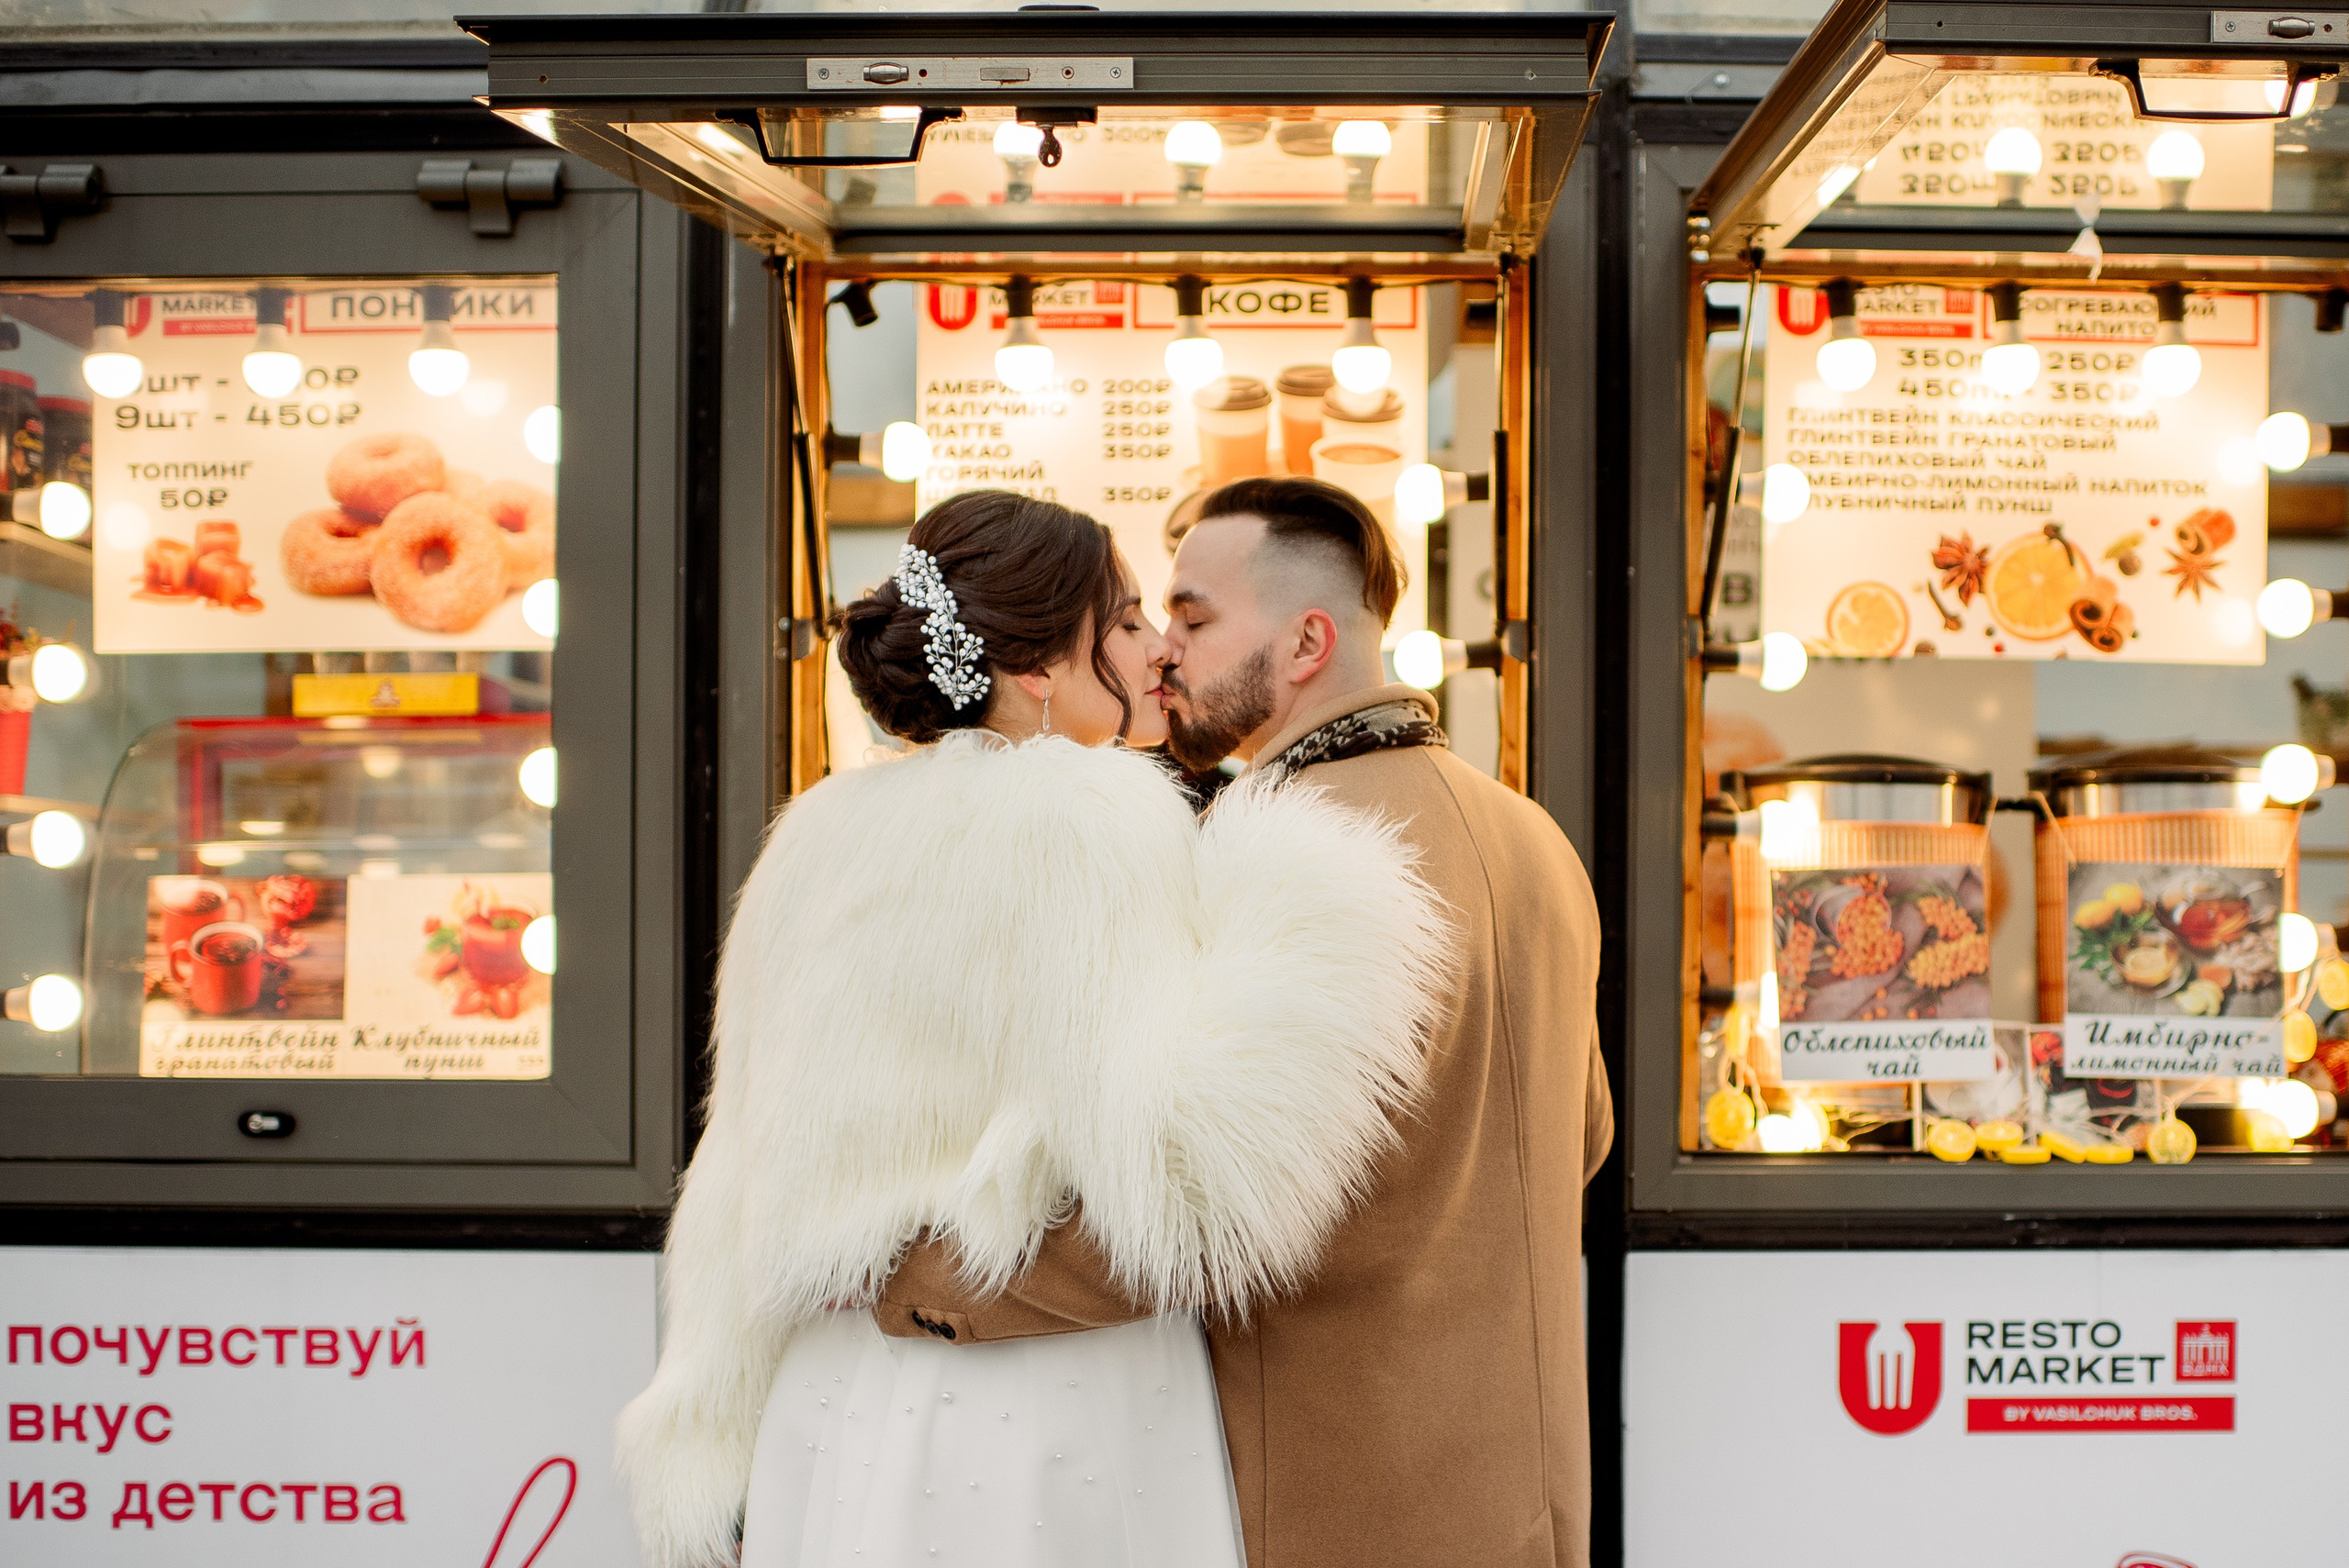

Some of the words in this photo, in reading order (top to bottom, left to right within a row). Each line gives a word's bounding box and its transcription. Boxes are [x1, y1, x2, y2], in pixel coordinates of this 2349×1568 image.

[331, 294, 536, 319] ПОНИКИ
[1208, 290, 1330, 315] КОФЕ
[1856, 299, 1938, 314] ARKET
[1788, 427, 1938, 445] ГЛИНТВЕЙН
[1950, 431, 2116, 450] ГРАНАТОВЫЙ
[1789, 449, 1985, 467] ОБЛЕПИХОВЫЙ
[1997, 451, 2047, 469] ЧАЙ
[1807, 473, 2078, 492] МБИРНО-ЛИМОННЫЙ
[2089, 478, 2209, 496] НАПИТОК
[1809, 492, 1965, 511] ЛУБНИЧНЫЙ
[1977, 496, 2053, 513] ПУНШ
[1784, 1026, 1989, 1053] Облепиховый
[1866, 1053, 1922, 1077] чай
[2071, 1054, 2220, 1074] лимонный
[2232, 1054, 2283, 1075] чай
[1967, 1321, 2121, 1349] RESTO
[7, 1318, 426, 1377] почувствуй
[1967, 1355, 2166, 1384] MARKET
[2003, 1406, 2030, 1421] BY
[2032, 1406, 2138, 1421] VASILCHUK
[8, 1404, 173, 1453] вкус
[8, 1481, 87, 1520] из
[112, 1481, 407, 1529] детства
